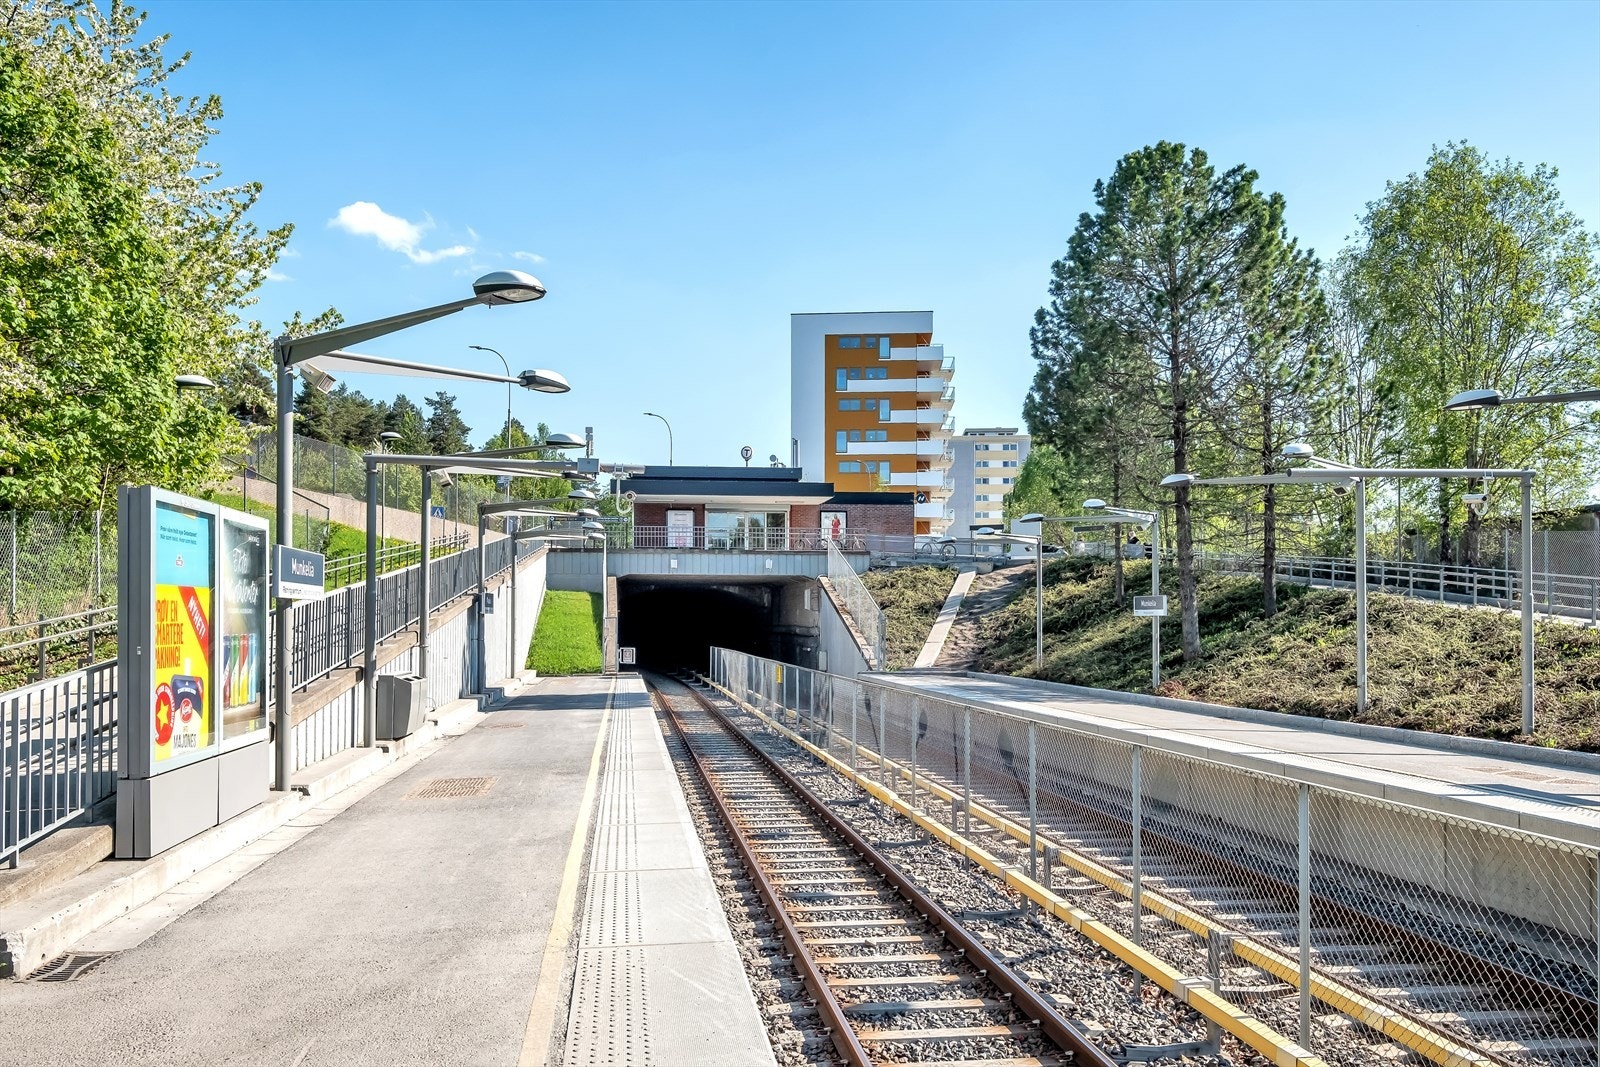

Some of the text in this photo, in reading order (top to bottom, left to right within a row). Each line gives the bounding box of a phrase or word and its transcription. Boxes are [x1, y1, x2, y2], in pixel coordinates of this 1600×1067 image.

[291, 557, 315, 578] Munkelia
[170, 600, 178, 622] EN
[188, 595, 206, 640] NYHET!
